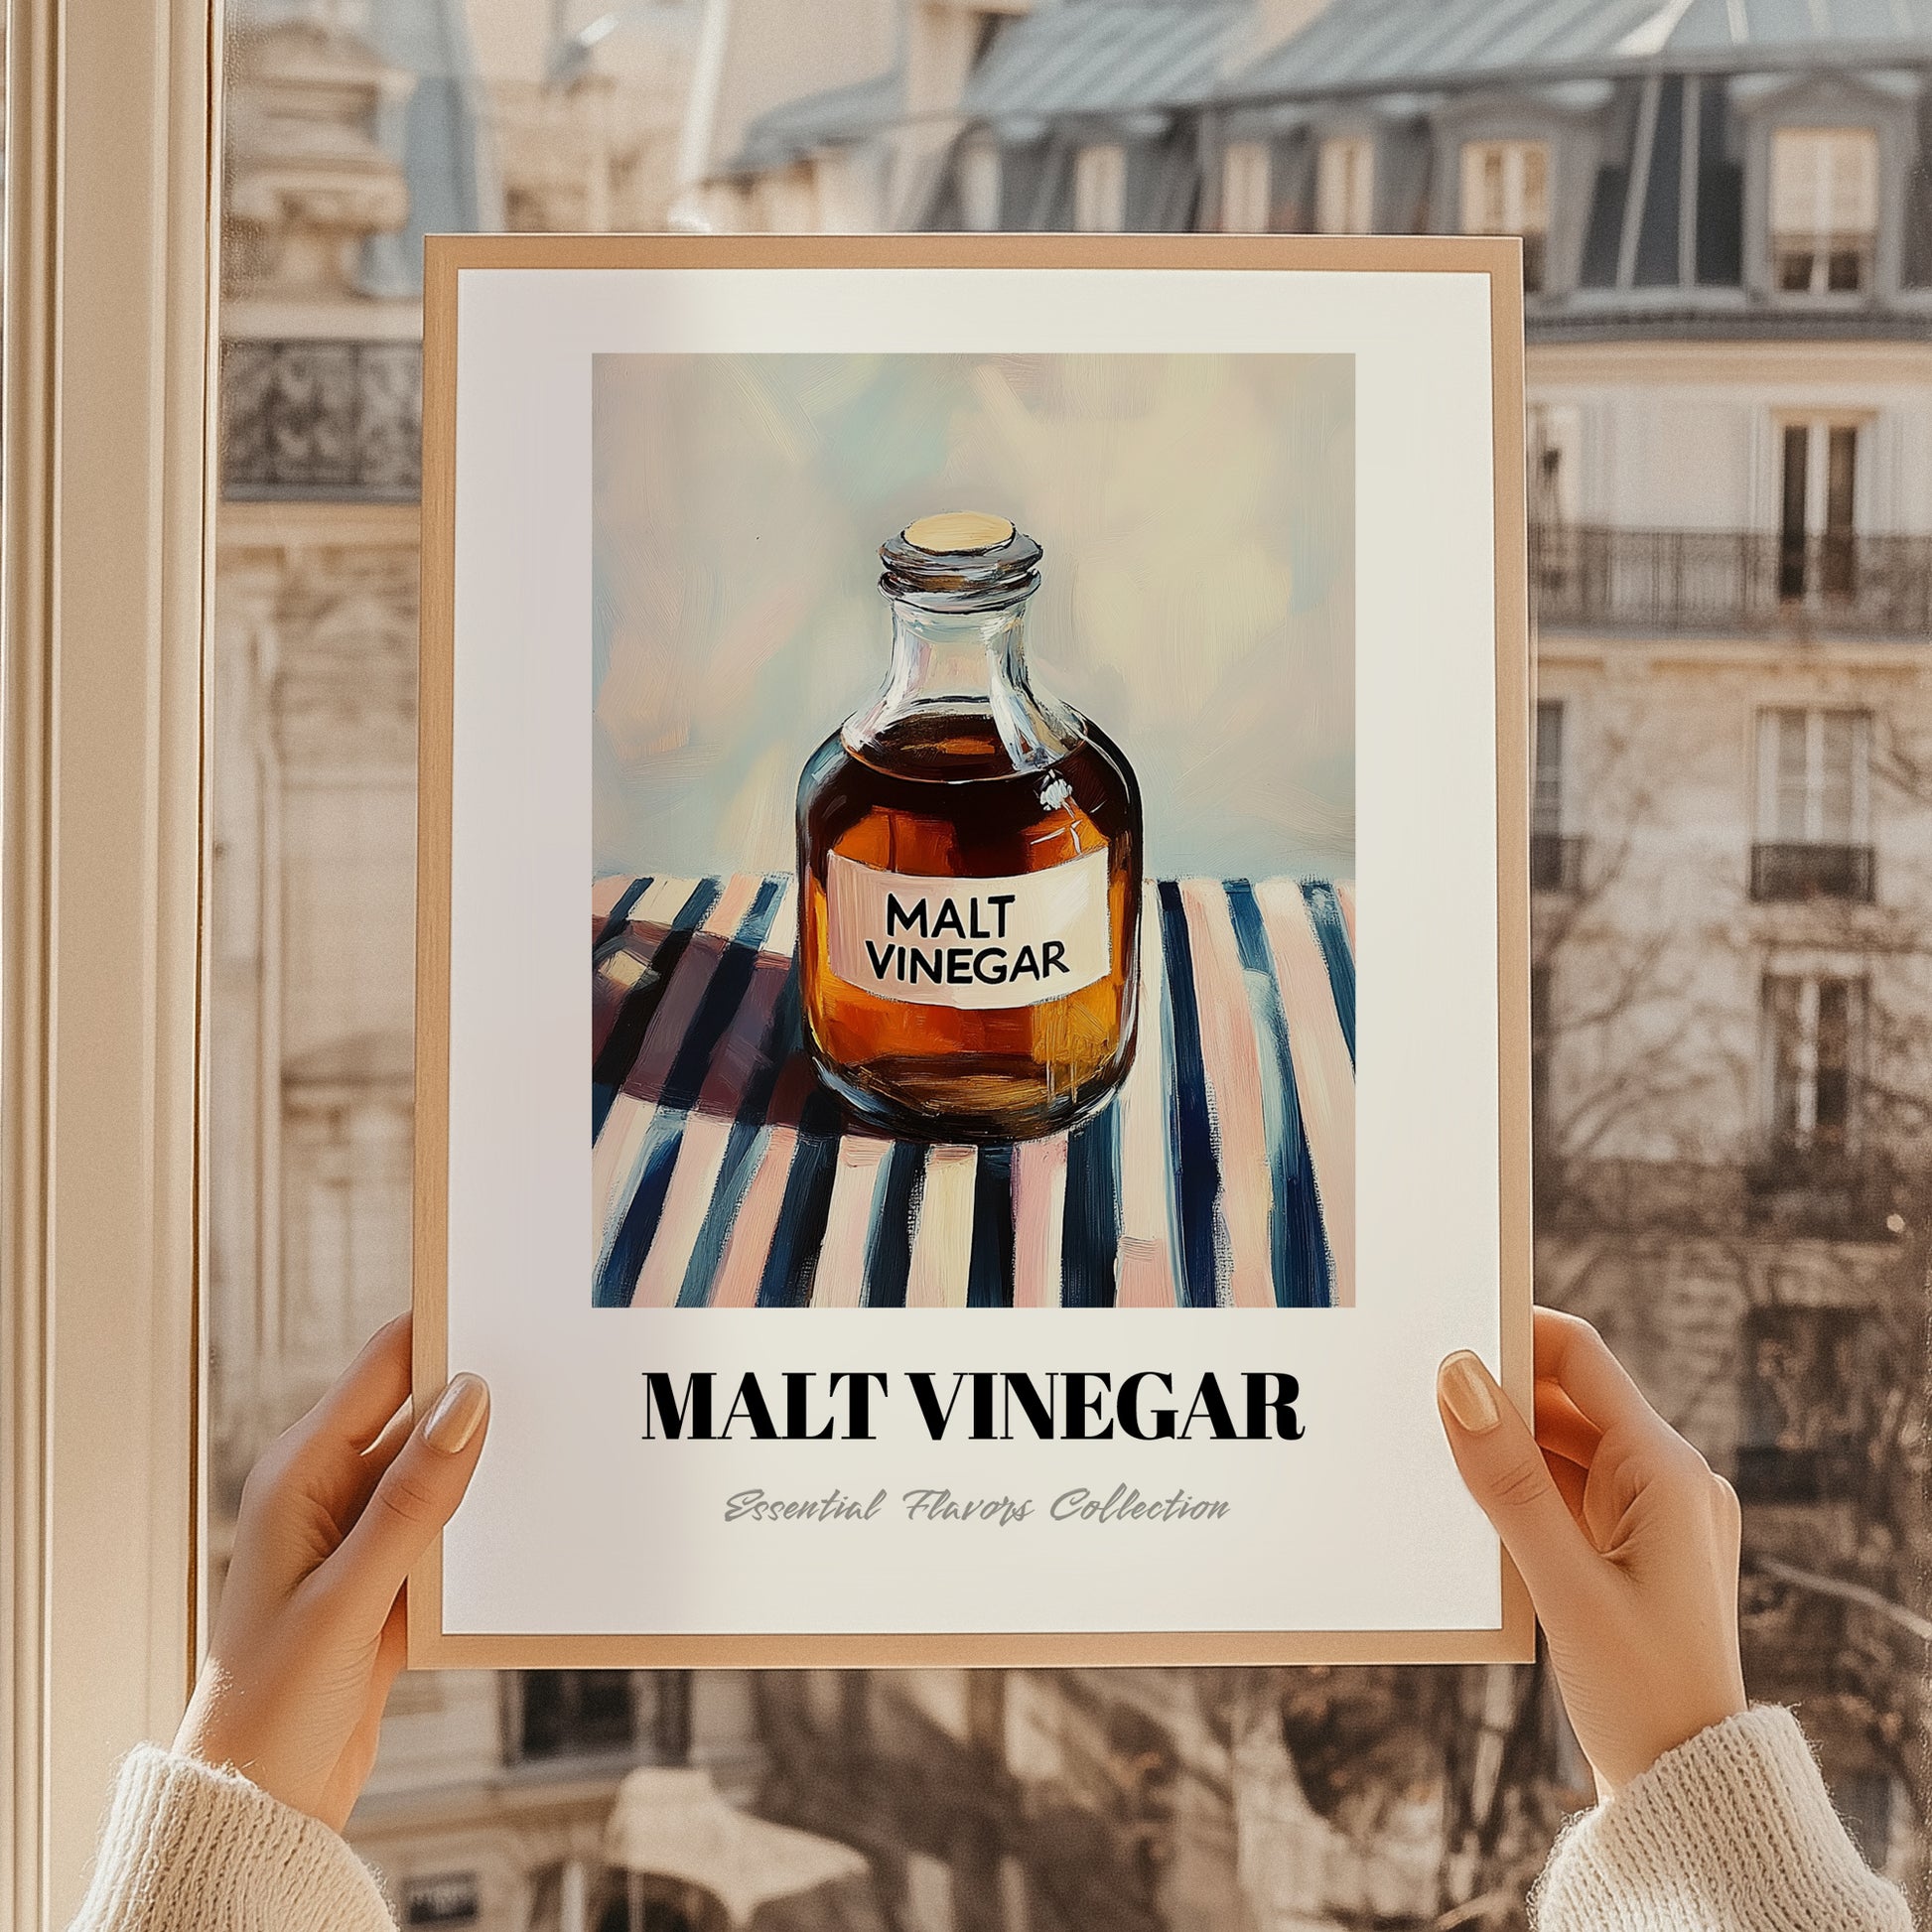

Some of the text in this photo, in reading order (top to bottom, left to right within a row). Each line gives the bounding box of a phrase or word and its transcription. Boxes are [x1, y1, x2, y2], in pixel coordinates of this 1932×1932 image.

[887, 893, 1016, 939] MALT
[865, 940, 1070, 985] VINEGAR
[641, 1371, 1307, 1442] MALT VINEGAR
[724, 1481, 1231, 1528] Essential Flavors Collection
